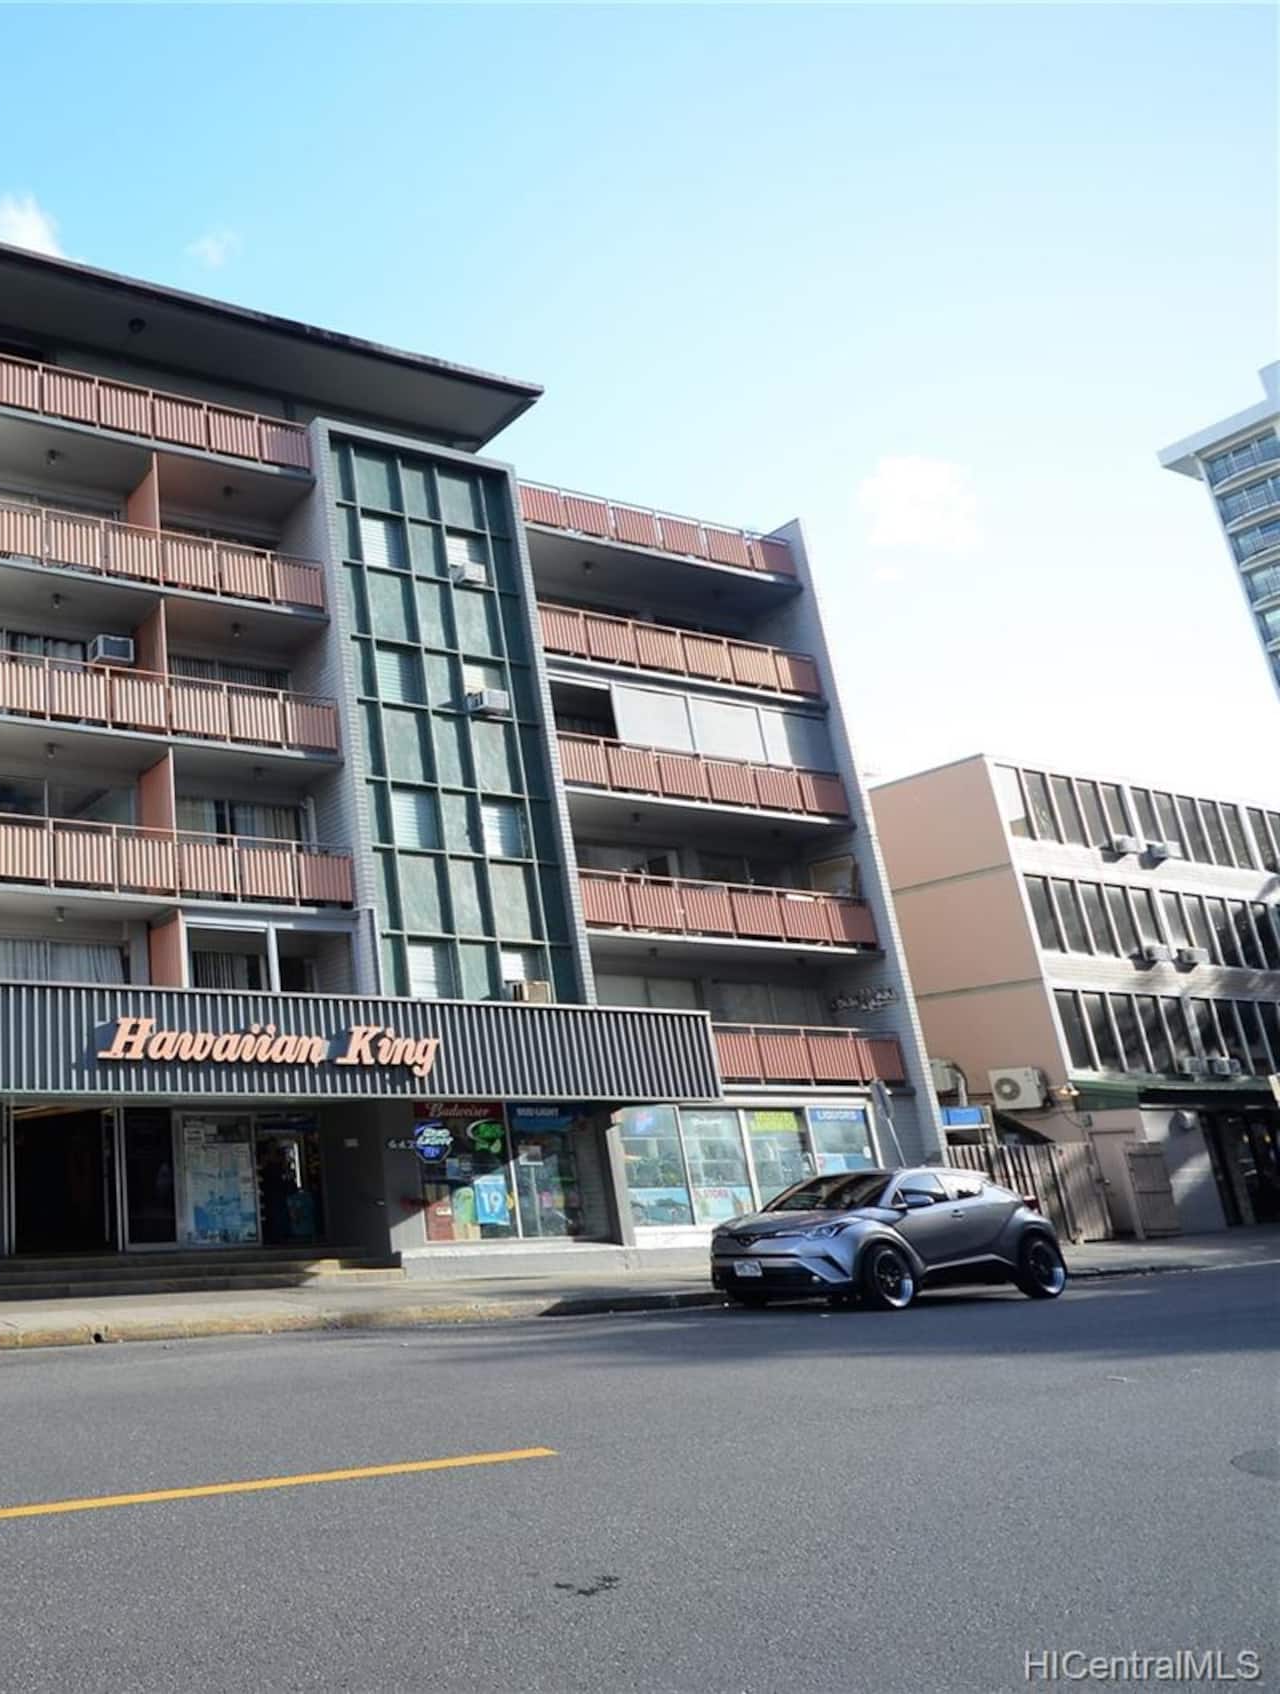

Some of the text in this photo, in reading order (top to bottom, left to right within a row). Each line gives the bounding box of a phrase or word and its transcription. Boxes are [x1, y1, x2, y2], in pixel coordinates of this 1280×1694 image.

[96, 1017, 440, 1077] Hawaiian King
[425, 1103, 490, 1118] Budweiser
[480, 1191, 502, 1214] 19
